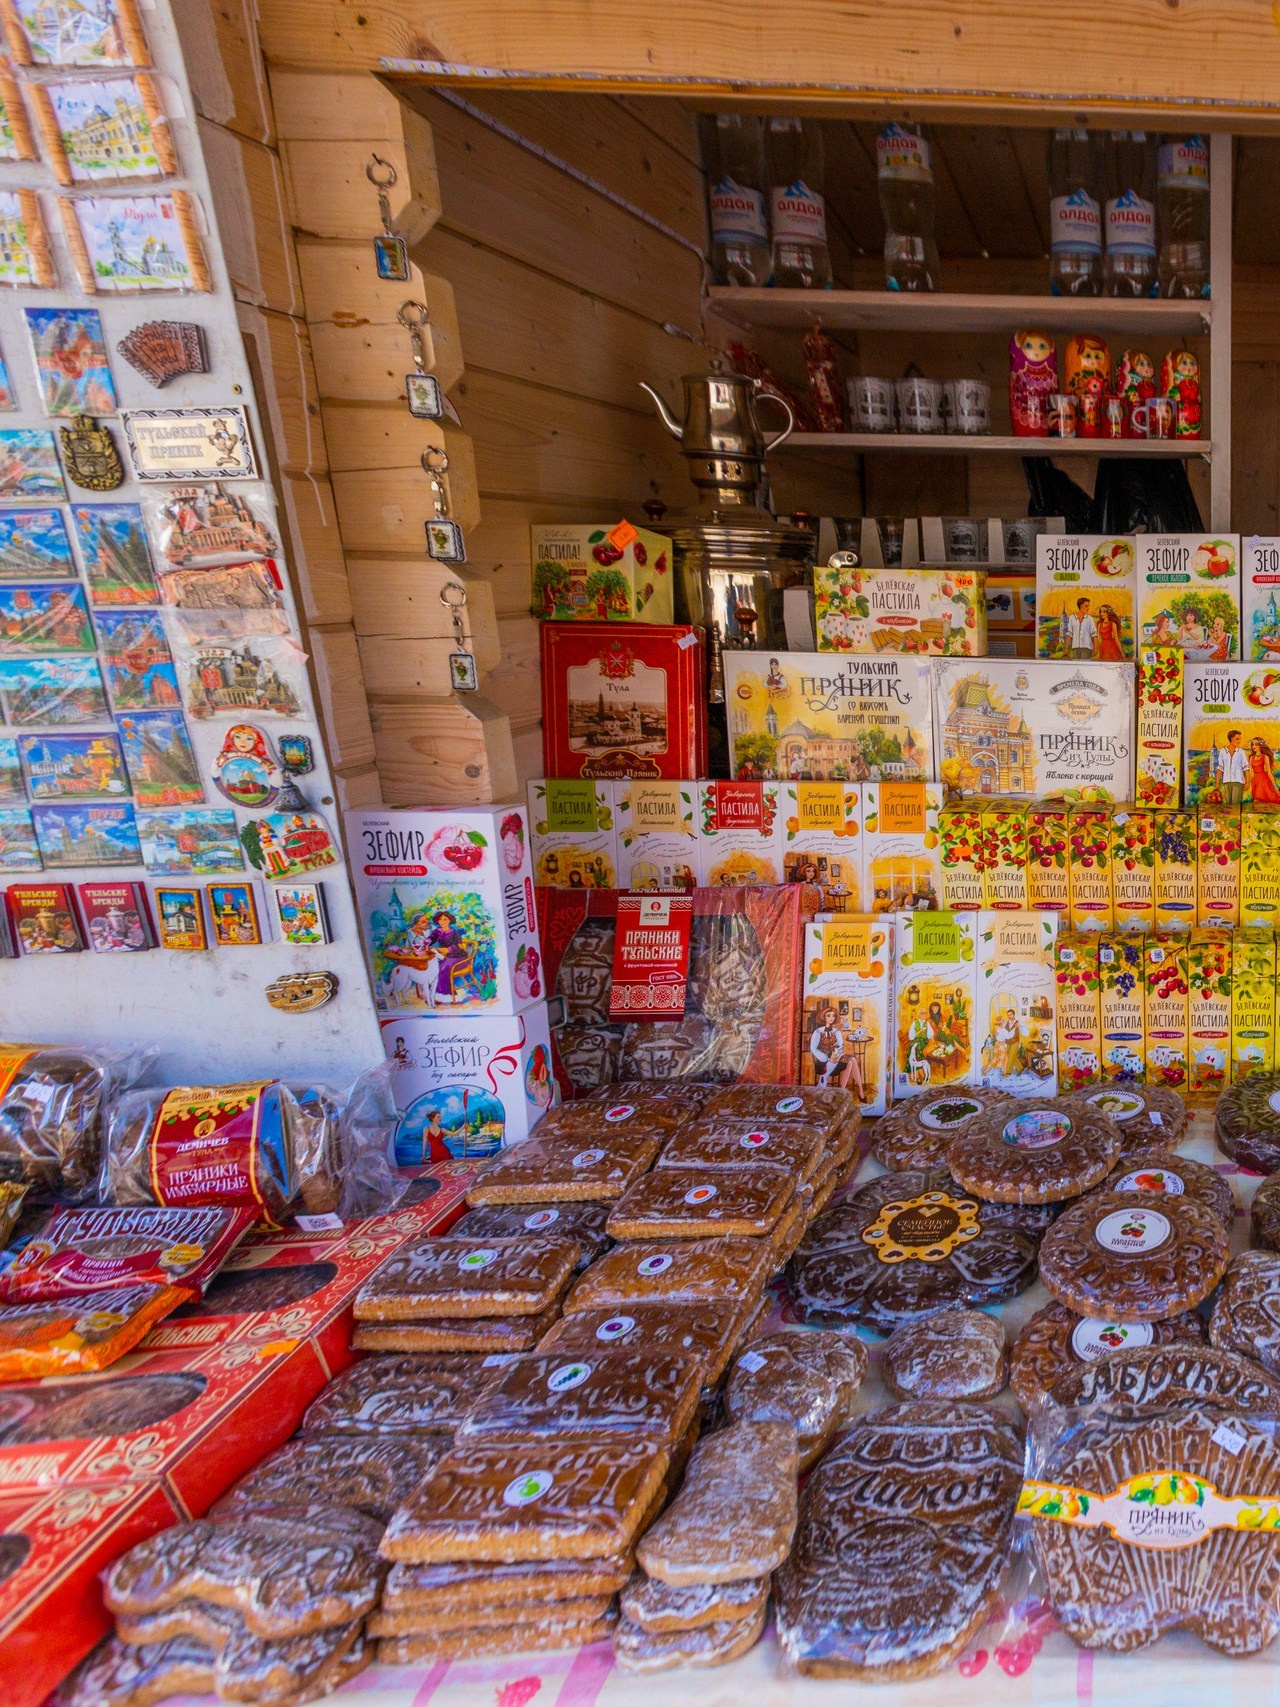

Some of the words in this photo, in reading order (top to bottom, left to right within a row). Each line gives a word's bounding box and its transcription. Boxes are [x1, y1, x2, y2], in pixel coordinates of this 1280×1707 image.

[1046, 548, 1088, 571] ЗЕФИР
[1147, 548, 1189, 572] ЗЕФИР
[876, 579, 915, 593] БЕЛЁВСКАЯ
[871, 592, 920, 611] ПАСТИЛА
[847, 660, 898, 676] ТУЛЬСКИЙ
[606, 682, 630, 694] Тула
[800, 673, 909, 704] ПРЯНИК
[1194, 678, 1239, 703] ЗЕФИР
[847, 701, 857, 711] СО
[867, 714, 900, 725] СГУЩЕНКИ
[1141, 722, 1179, 738] ПАСТИЛА
[1040, 732, 1122, 755] ПРЯНИК
[1070, 753, 1081, 763] из
[583, 767, 623, 779] Тульский
[625, 767, 658, 779] Пряник
[1046, 771, 1074, 780] Яблоко
[1081, 772, 1114, 782] корицей
[552, 802, 592, 815] ПАСТИЛА
[638, 802, 676, 815] ПАСТИЛА
[721, 802, 760, 815] ПАСТИЛА
[803, 804, 841, 817] ПАСТИЛА
[884, 804, 922, 817] ПАСТИЛА
[362, 829, 424, 862] ЗЕФИР
[946, 872, 982, 883] БЕЛЁВСКАЯ
[989, 872, 1023, 883] БЕЛЁВСКАЯ
[1031, 872, 1066, 882] БЕЛЁВСКАЯ
[945, 885, 983, 900] ПАСТИЛА
[987, 884, 1025, 899] ПАСТИЛА
[1029, 884, 1067, 898] ПАСТИЛА
[1072, 885, 1110, 898] ПАСТИЛА
[1115, 885, 1153, 899] ПАСТИЛА
[1157, 885, 1195, 899] ПАСТИЛА
[1200, 885, 1238, 899] ПАСТИЛА
[1243, 885, 1280, 900] ПАСТИЛА
[508, 882, 524, 941] ЗЕФИР
[624, 930, 681, 945] ПРЯНИКИ
[918, 932, 956, 946] ПАСТИЛА
[1000, 932, 1037, 946] ПАСТИЛА
[621, 945, 684, 961] ТУЛЬСКИЕ
[827, 944, 866, 958] ПАСТИЛА
[1060, 1002, 1096, 1012] БЕЛЁВСКАЯ
[1059, 1016, 1098, 1029] ПАСТИЛА
[1104, 1016, 1142, 1029] ПАСТИЛА
[1148, 1014, 1186, 1027] ПАСТИЛА
[1191, 1014, 1229, 1028] ПАСТИЛА
[1234, 1014, 1272, 1027] ПАСТИЛА
[419, 1045, 490, 1069] ЗЕФИР
[176, 1137, 229, 1153] ДЕМИЧЕВ
[169, 1163, 239, 1185] ПРЯНИКИ
[164, 1176, 249, 1199] ИМБИРНЫЕ
[52, 1205, 224, 1248] ТУЛЬСКИЙ
[1128, 1507, 1202, 1527] ПРЯНИК
